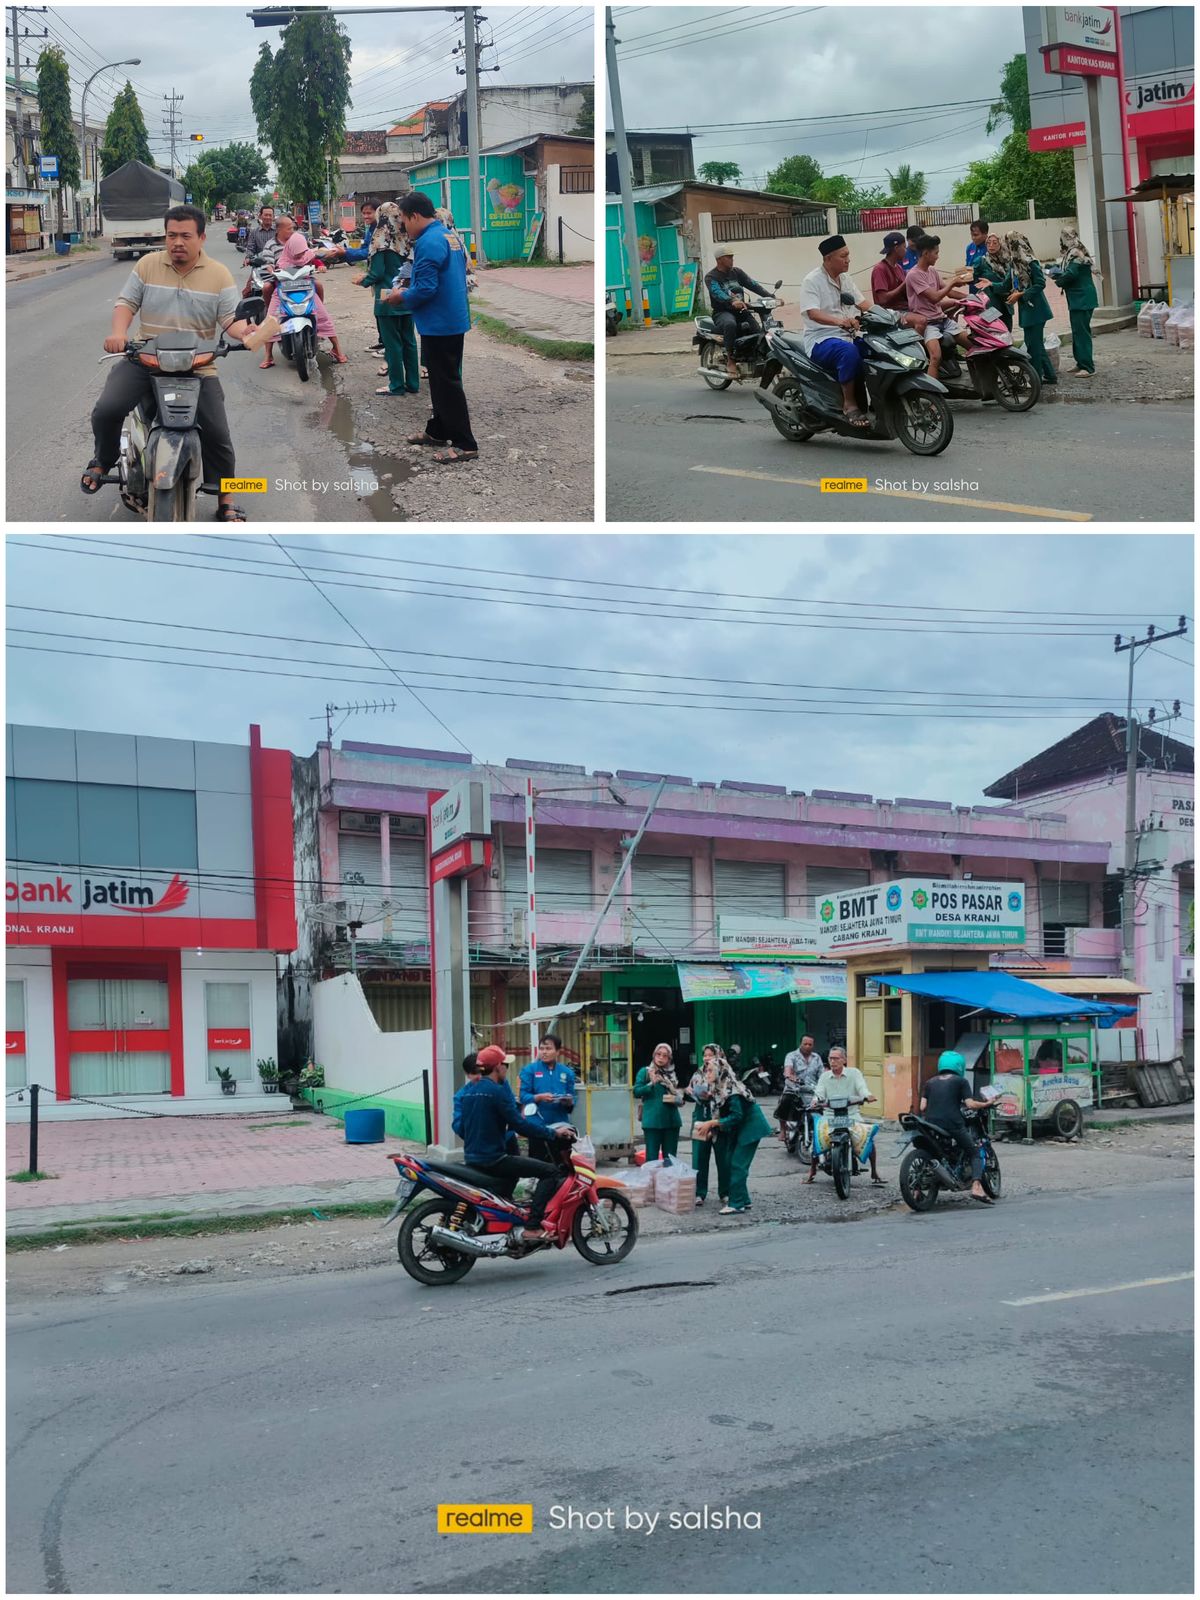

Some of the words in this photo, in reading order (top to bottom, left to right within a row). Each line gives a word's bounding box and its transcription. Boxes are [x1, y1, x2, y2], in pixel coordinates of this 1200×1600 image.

[1137, 80, 1185, 109] jatim
[81, 879, 154, 910] jatim
[932, 892, 957, 909] POS
[962, 894, 1003, 911] PASAR
[840, 894, 879, 920] BMT
[935, 913, 961, 921] DESA
[964, 914, 1000, 922] KRANJI
[37, 925, 74, 934] KRANJI
[840, 919, 869, 932] SEJAHTERA
[832, 931, 860, 942] CABANG
[861, 928, 887, 938] KRANJI
[915, 928, 928, 938] BMT
[953, 930, 984, 939] SEJAHTERA
